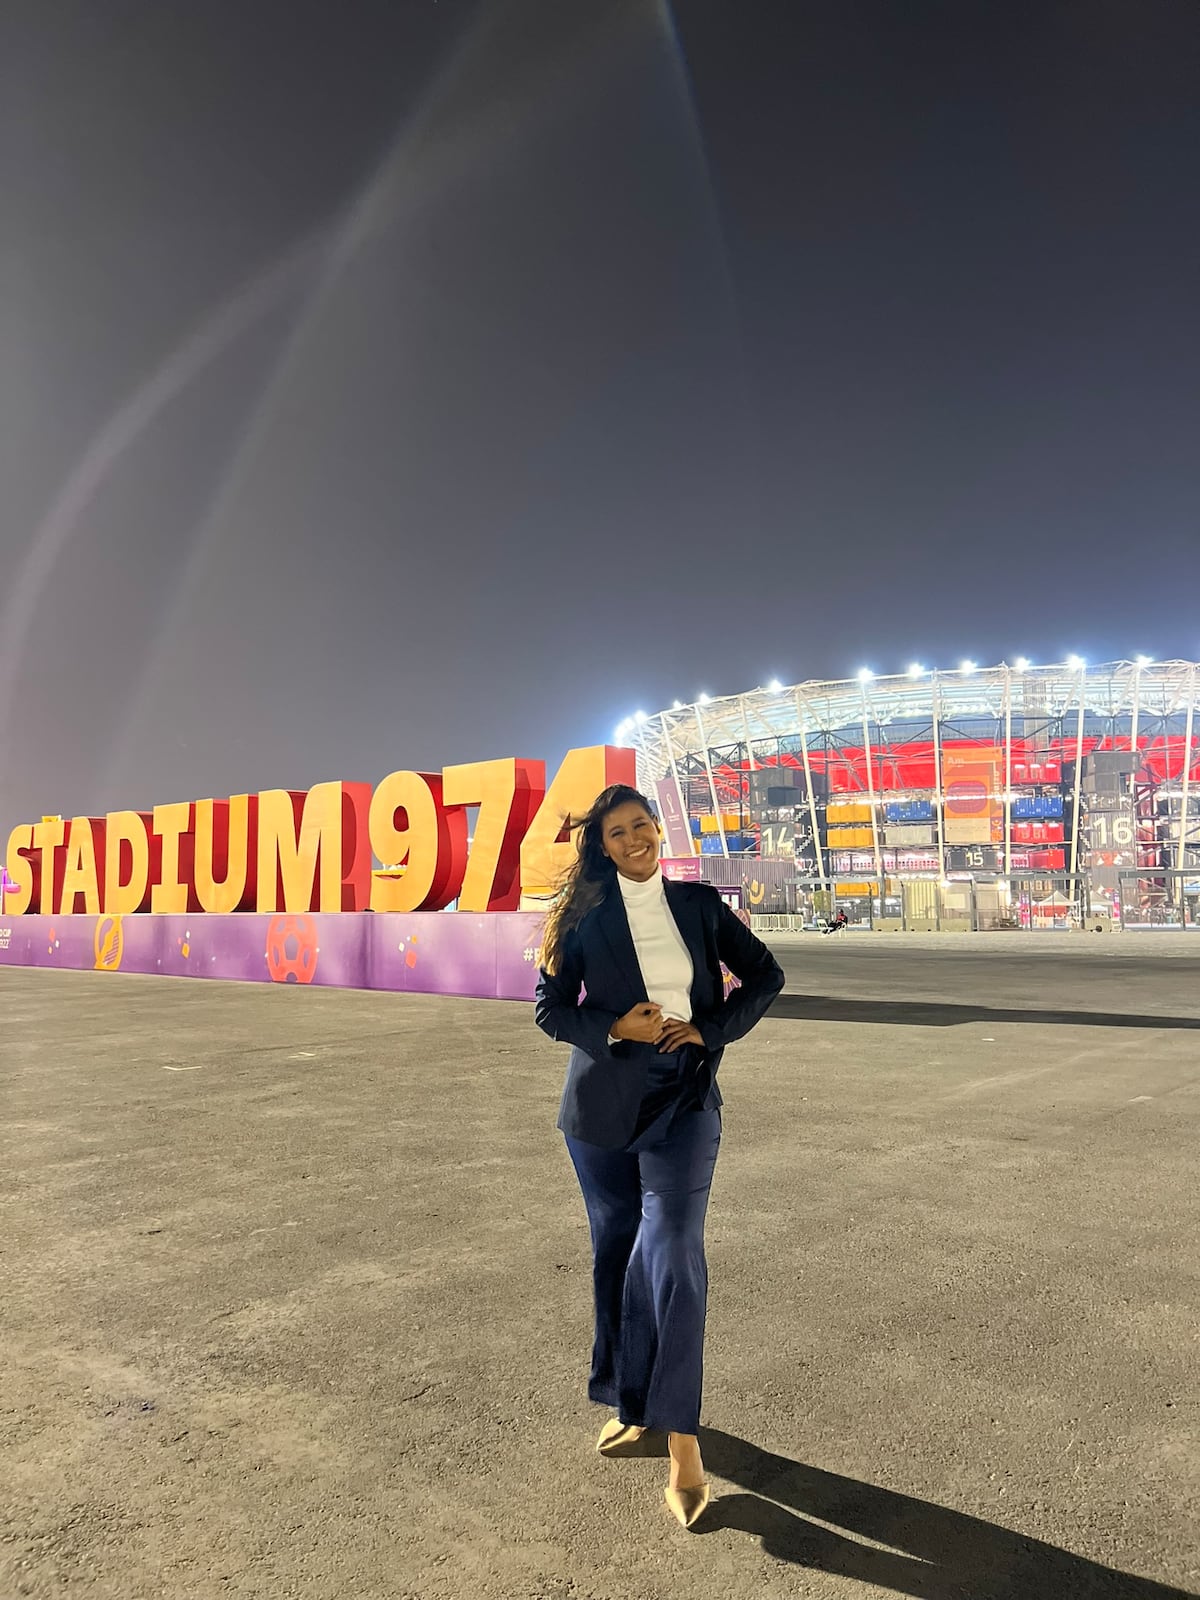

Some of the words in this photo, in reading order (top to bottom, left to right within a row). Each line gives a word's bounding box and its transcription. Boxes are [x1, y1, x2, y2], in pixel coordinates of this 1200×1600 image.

[4, 781, 345, 914] STADIUM
[369, 745, 621, 912] 974
[762, 827, 793, 855] 14
[1093, 817, 1132, 845] 16
[966, 851, 984, 866] 15
